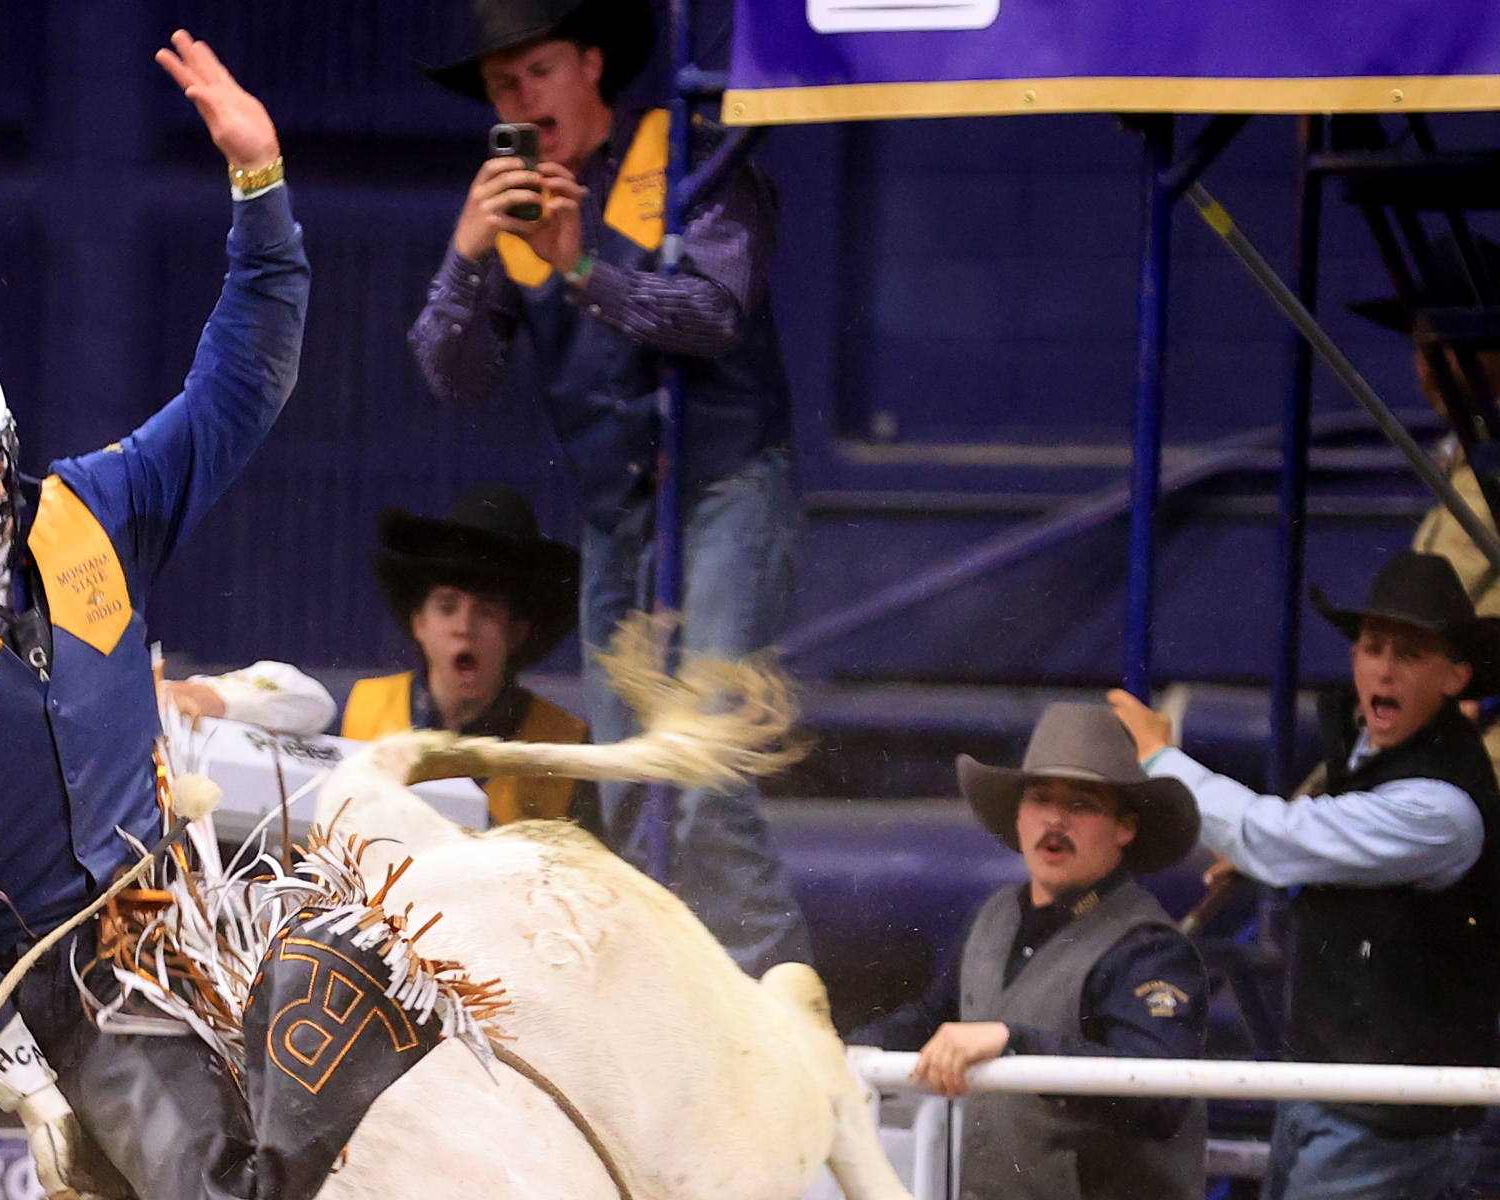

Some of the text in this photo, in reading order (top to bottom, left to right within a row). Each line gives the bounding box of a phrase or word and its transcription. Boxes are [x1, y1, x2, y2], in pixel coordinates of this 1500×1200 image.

[56, 552, 110, 586] MONTANA
[71, 571, 108, 593] STATE
[86, 599, 123, 624] RODEO
